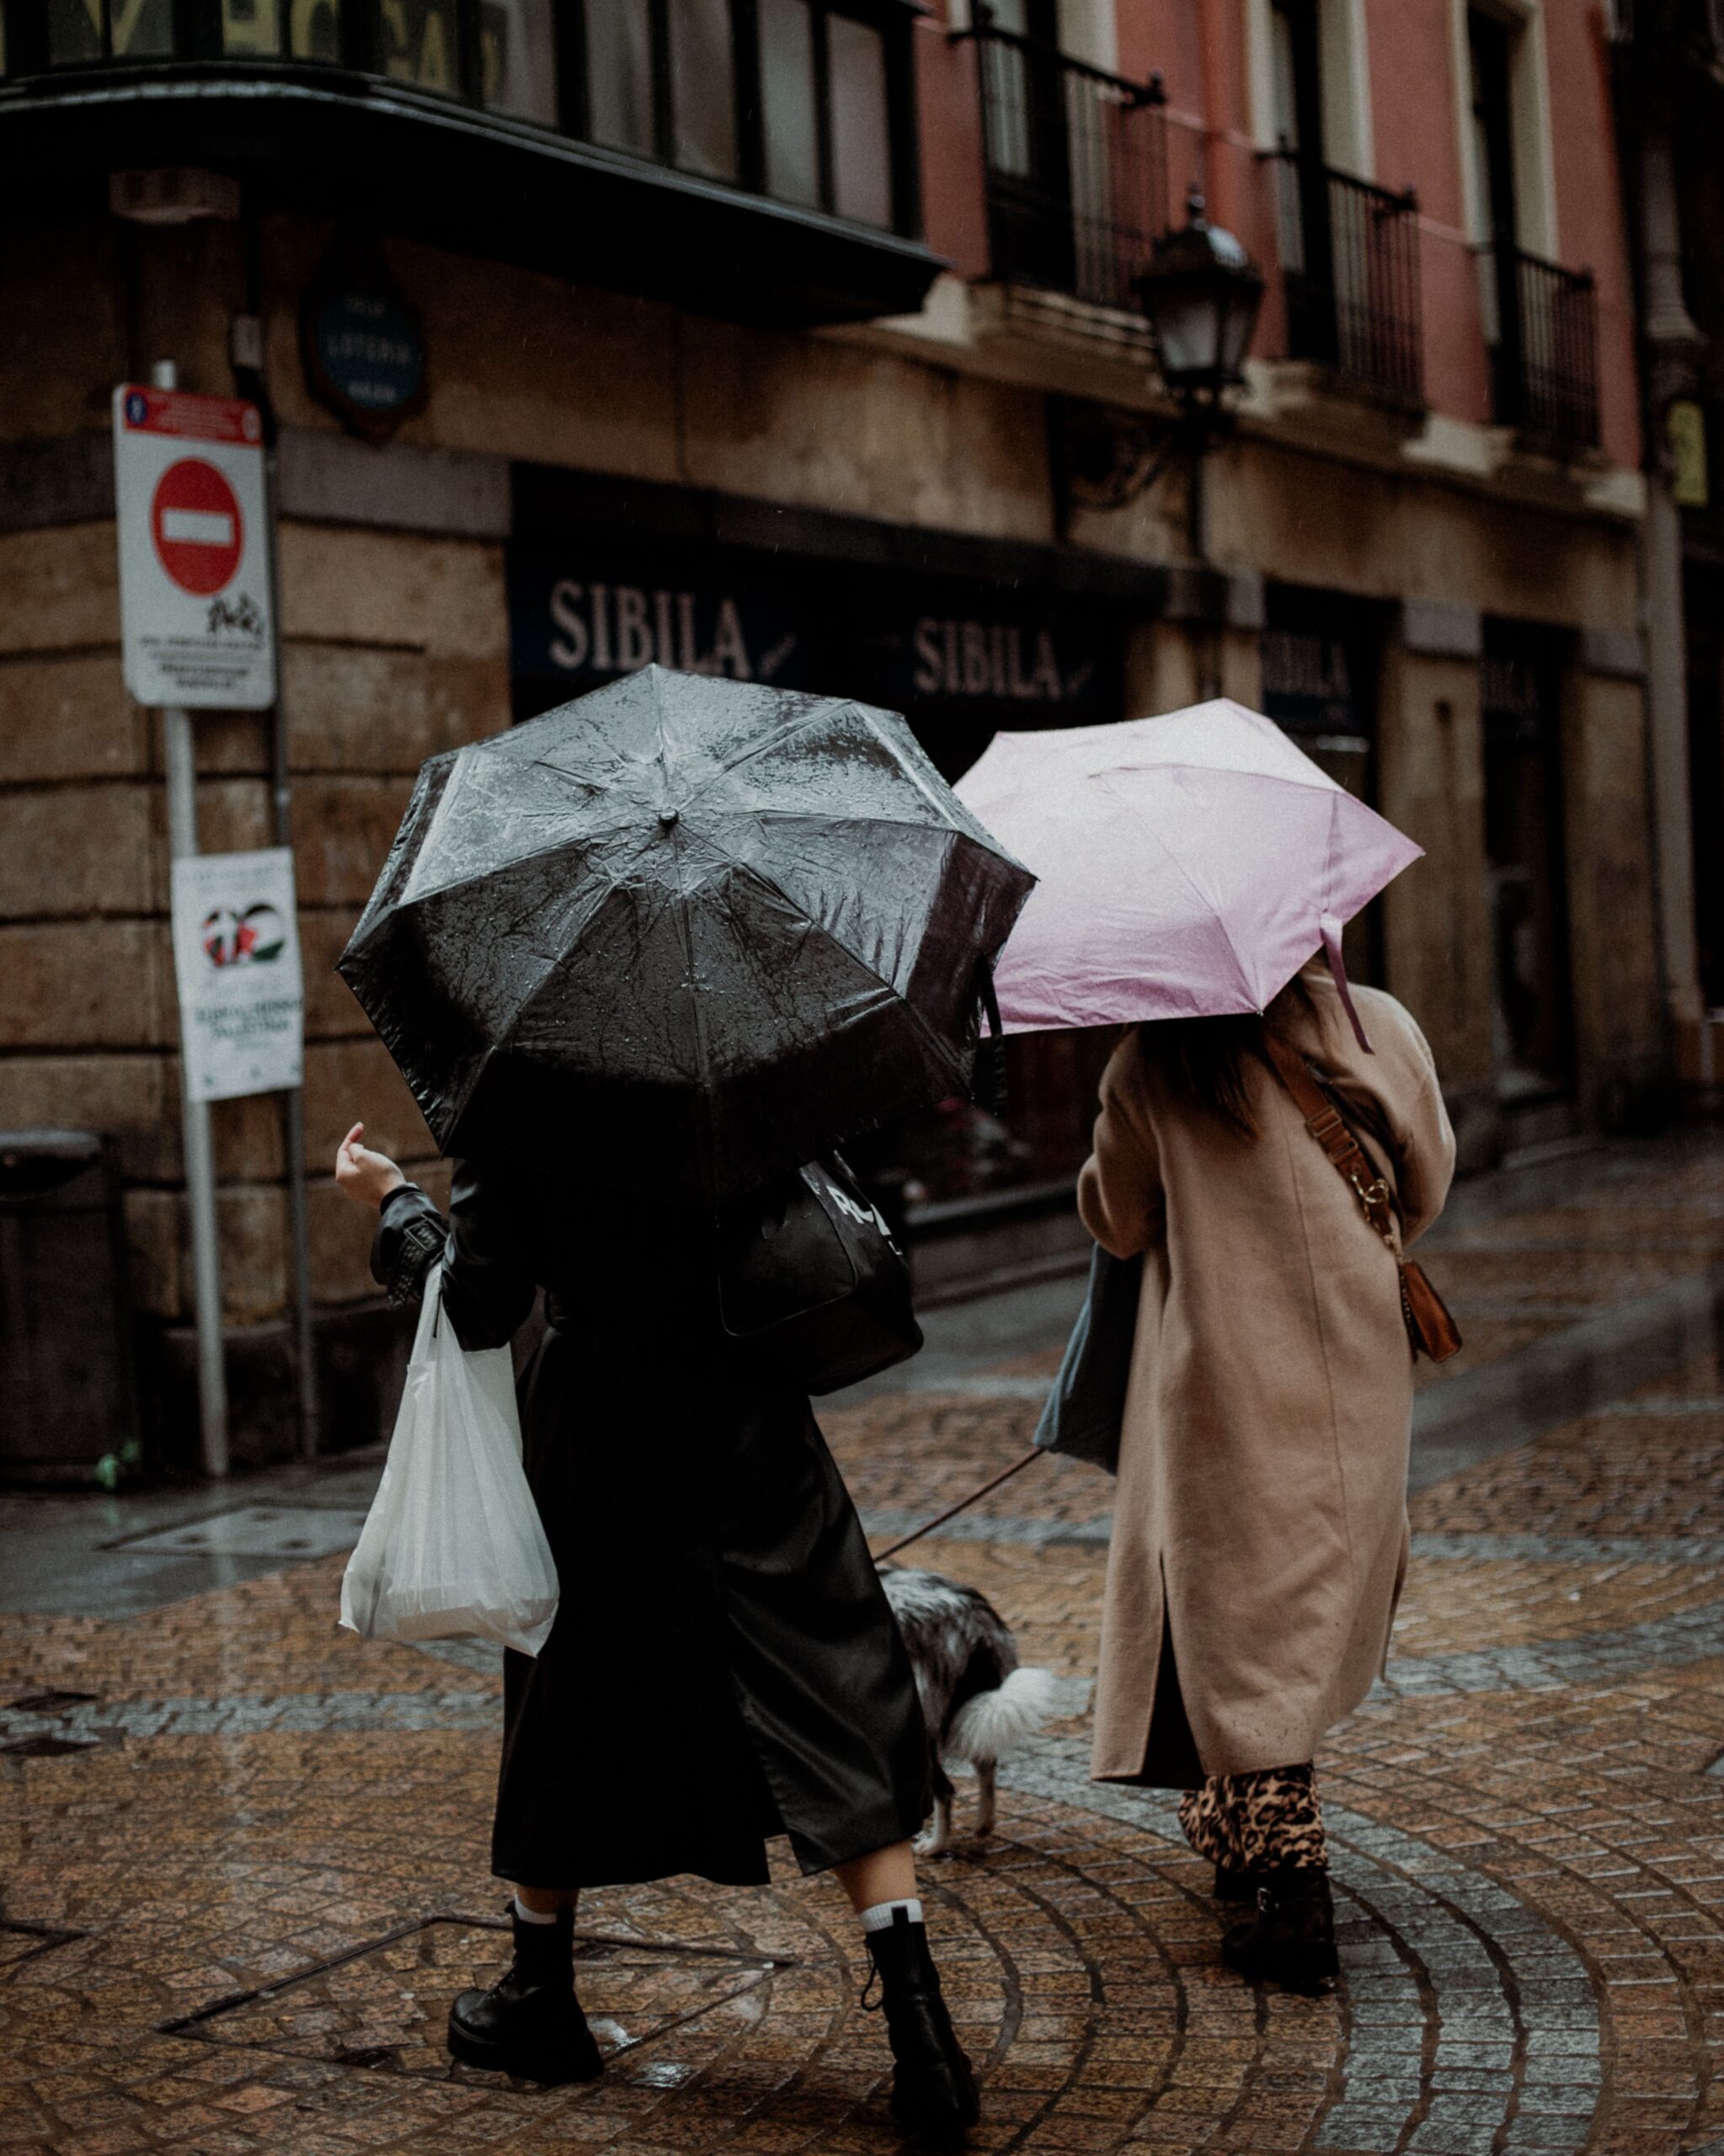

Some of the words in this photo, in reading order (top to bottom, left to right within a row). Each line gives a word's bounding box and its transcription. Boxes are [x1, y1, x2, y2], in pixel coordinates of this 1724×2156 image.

[548, 577, 754, 680] SIBILA
[913, 615, 1063, 702] SIBILA
[1262, 629, 1352, 701] IBILA
